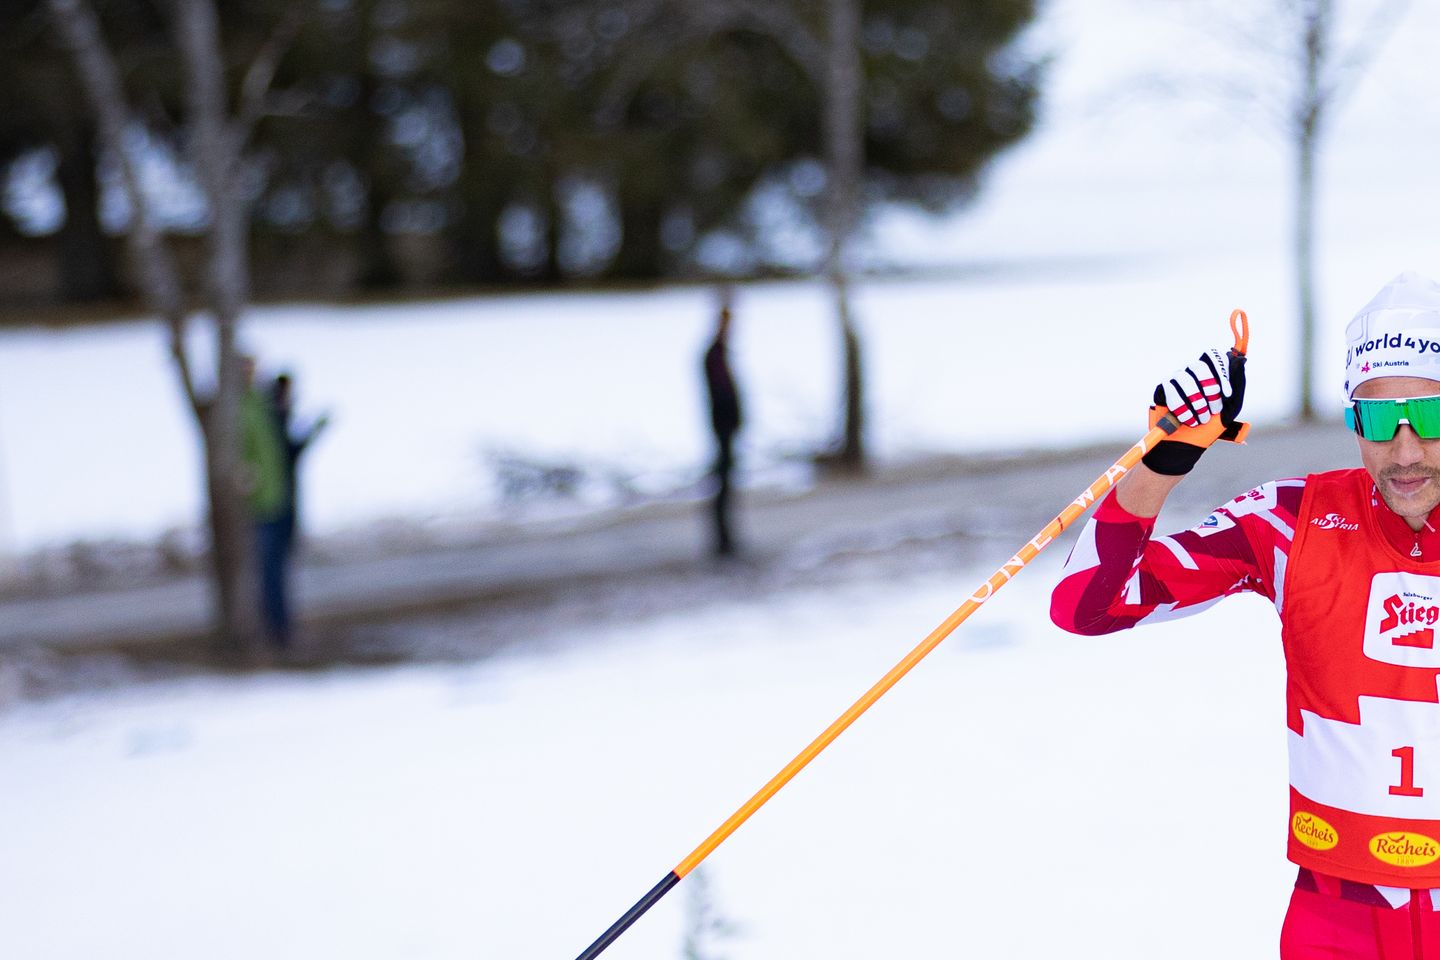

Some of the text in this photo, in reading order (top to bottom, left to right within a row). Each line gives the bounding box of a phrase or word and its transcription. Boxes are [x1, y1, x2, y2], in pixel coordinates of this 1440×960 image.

[1384, 360, 1410, 368] Austria
[1388, 746, 1424, 798] 1
[1294, 814, 1335, 844] Recheis
[1376, 836, 1437, 857] Recheis
